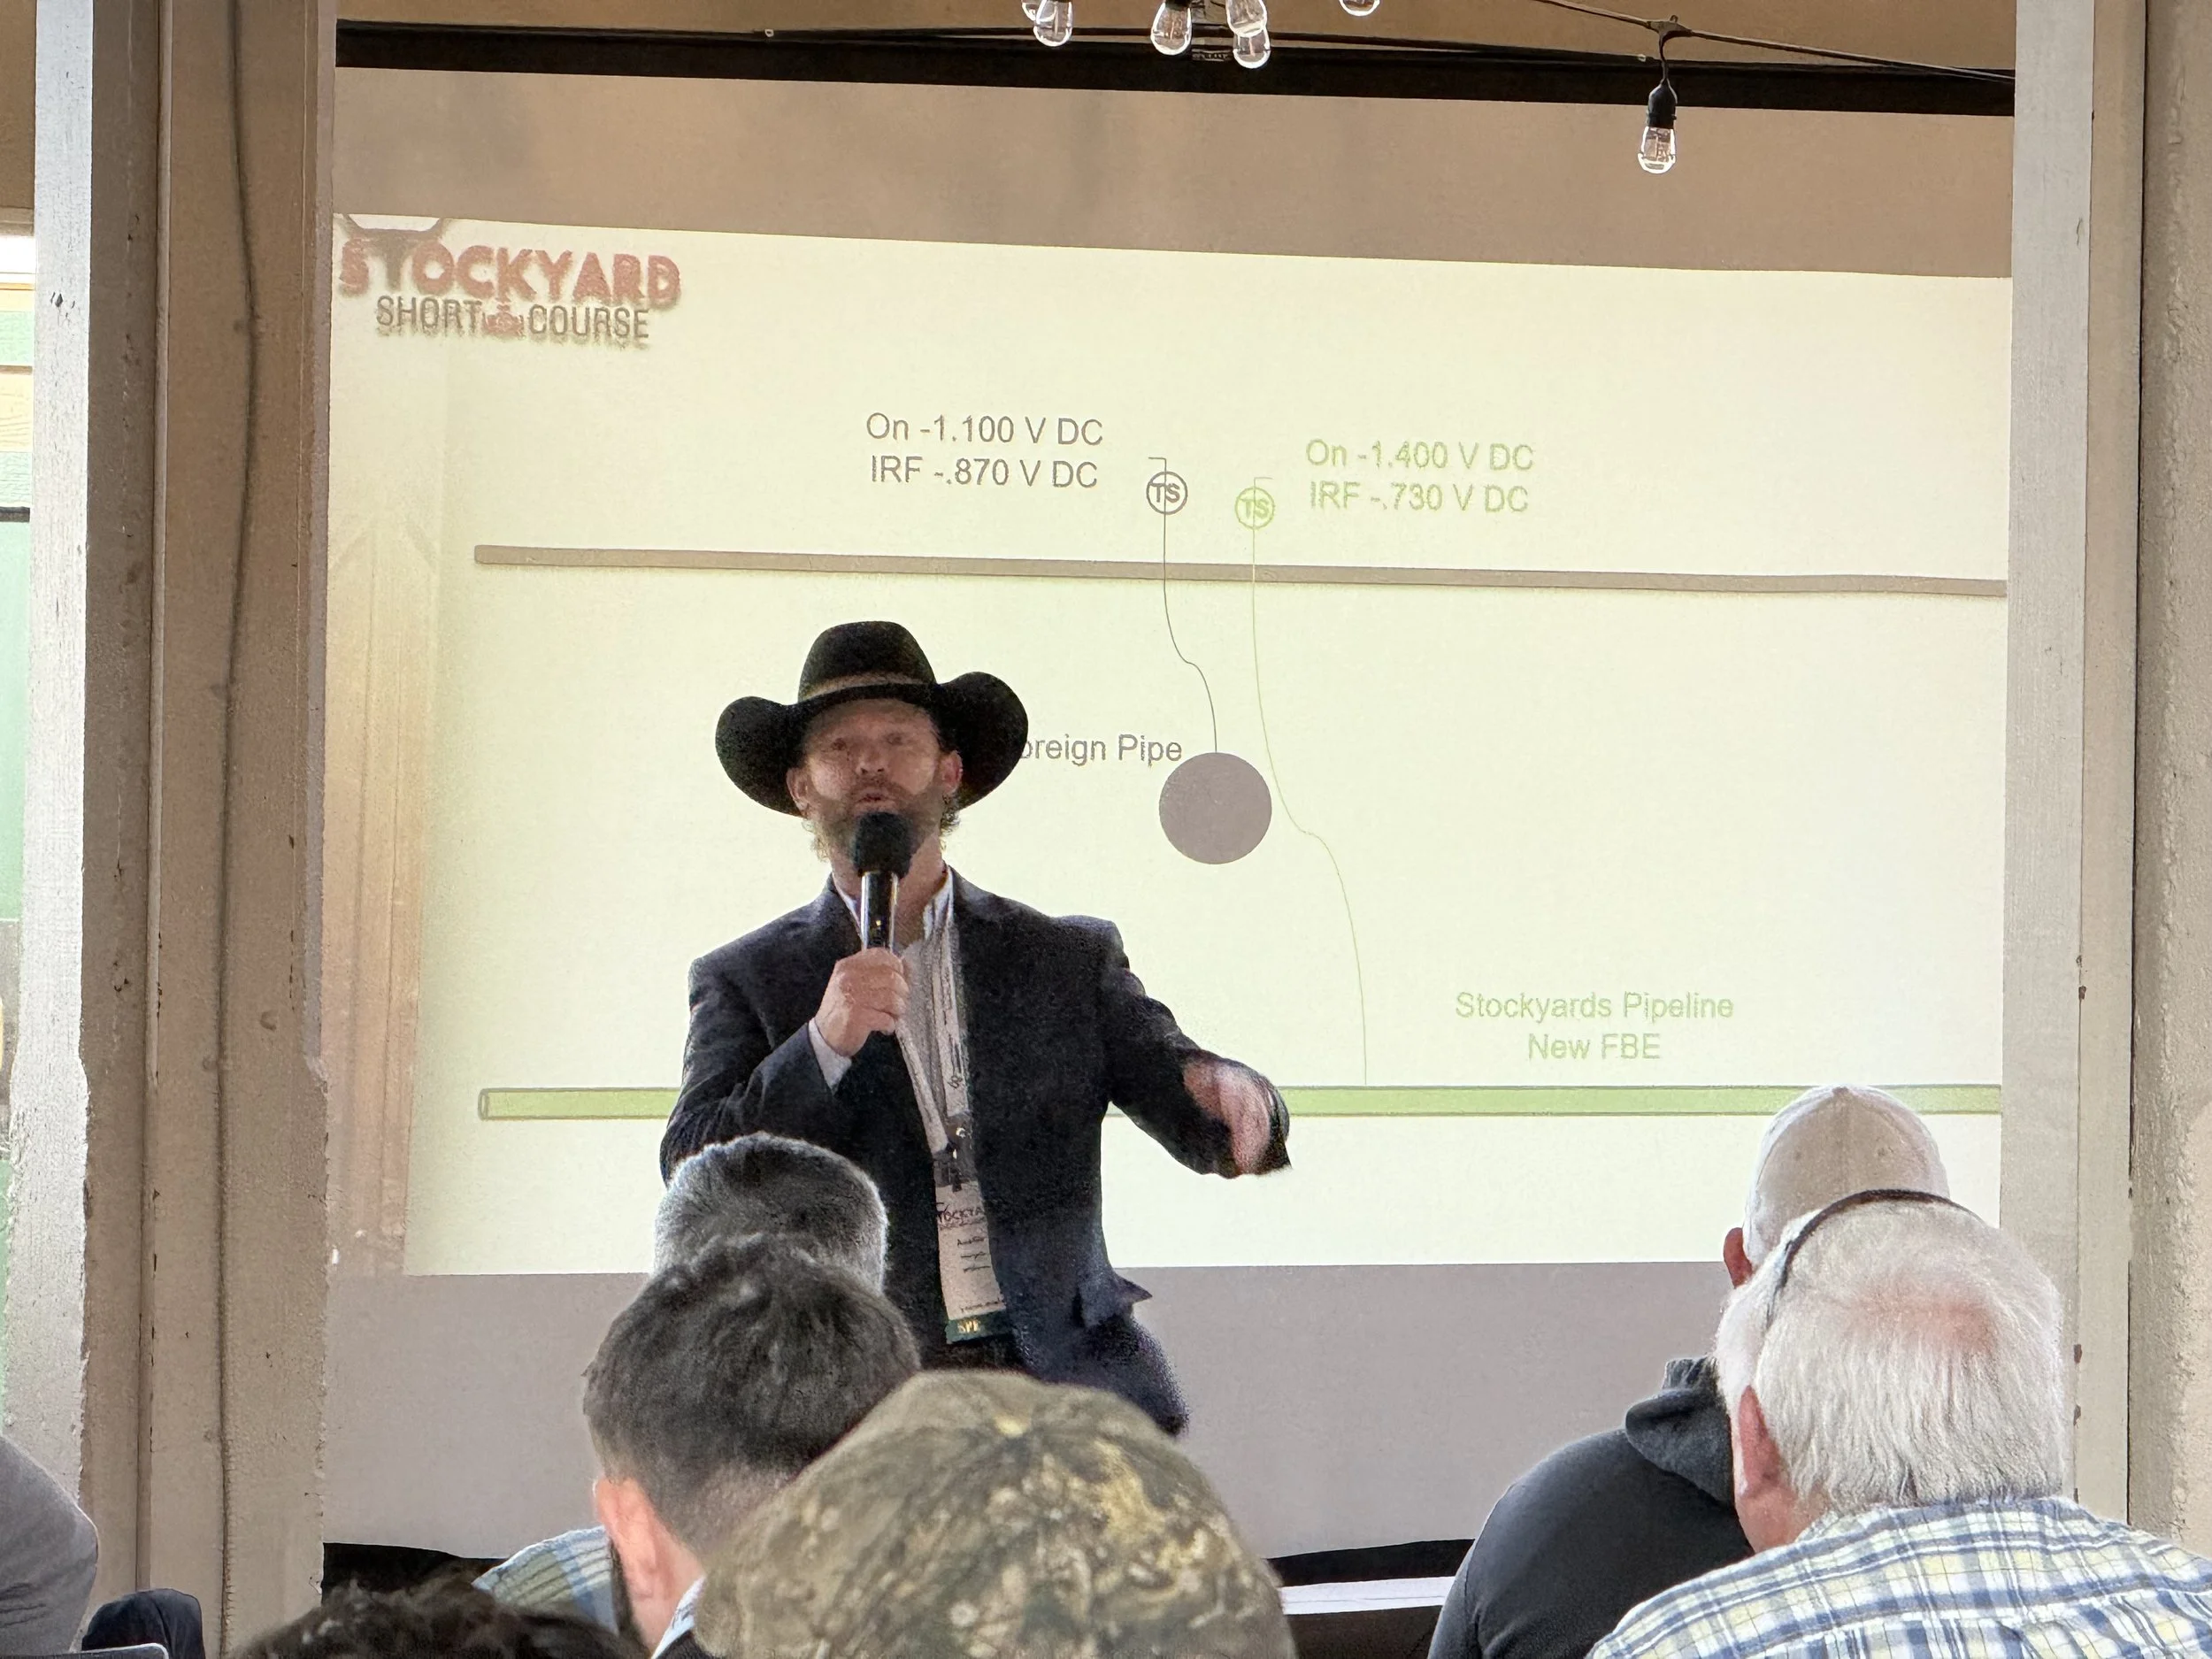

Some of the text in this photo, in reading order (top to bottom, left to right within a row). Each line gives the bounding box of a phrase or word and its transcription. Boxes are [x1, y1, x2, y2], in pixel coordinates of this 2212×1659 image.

[338, 239, 682, 310] STOCKYARD
[376, 295, 650, 339] SHORT COURSE
[866, 412, 1103, 446] On -1.100 V DC
[872, 455, 1098, 488] IRF -.870 V DC
[1306, 439, 1534, 472] On -1.400 V DC
[1150, 482, 1181, 503] TS
[1240, 498, 1270, 520] TS
[1310, 480, 1529, 513] IRF -.730 V DC
[1020, 733, 1184, 767] oreign Pipe
[1455, 992, 1734, 1024] Stockyards Pipeline
[1528, 1033, 1661, 1061] New FBE
